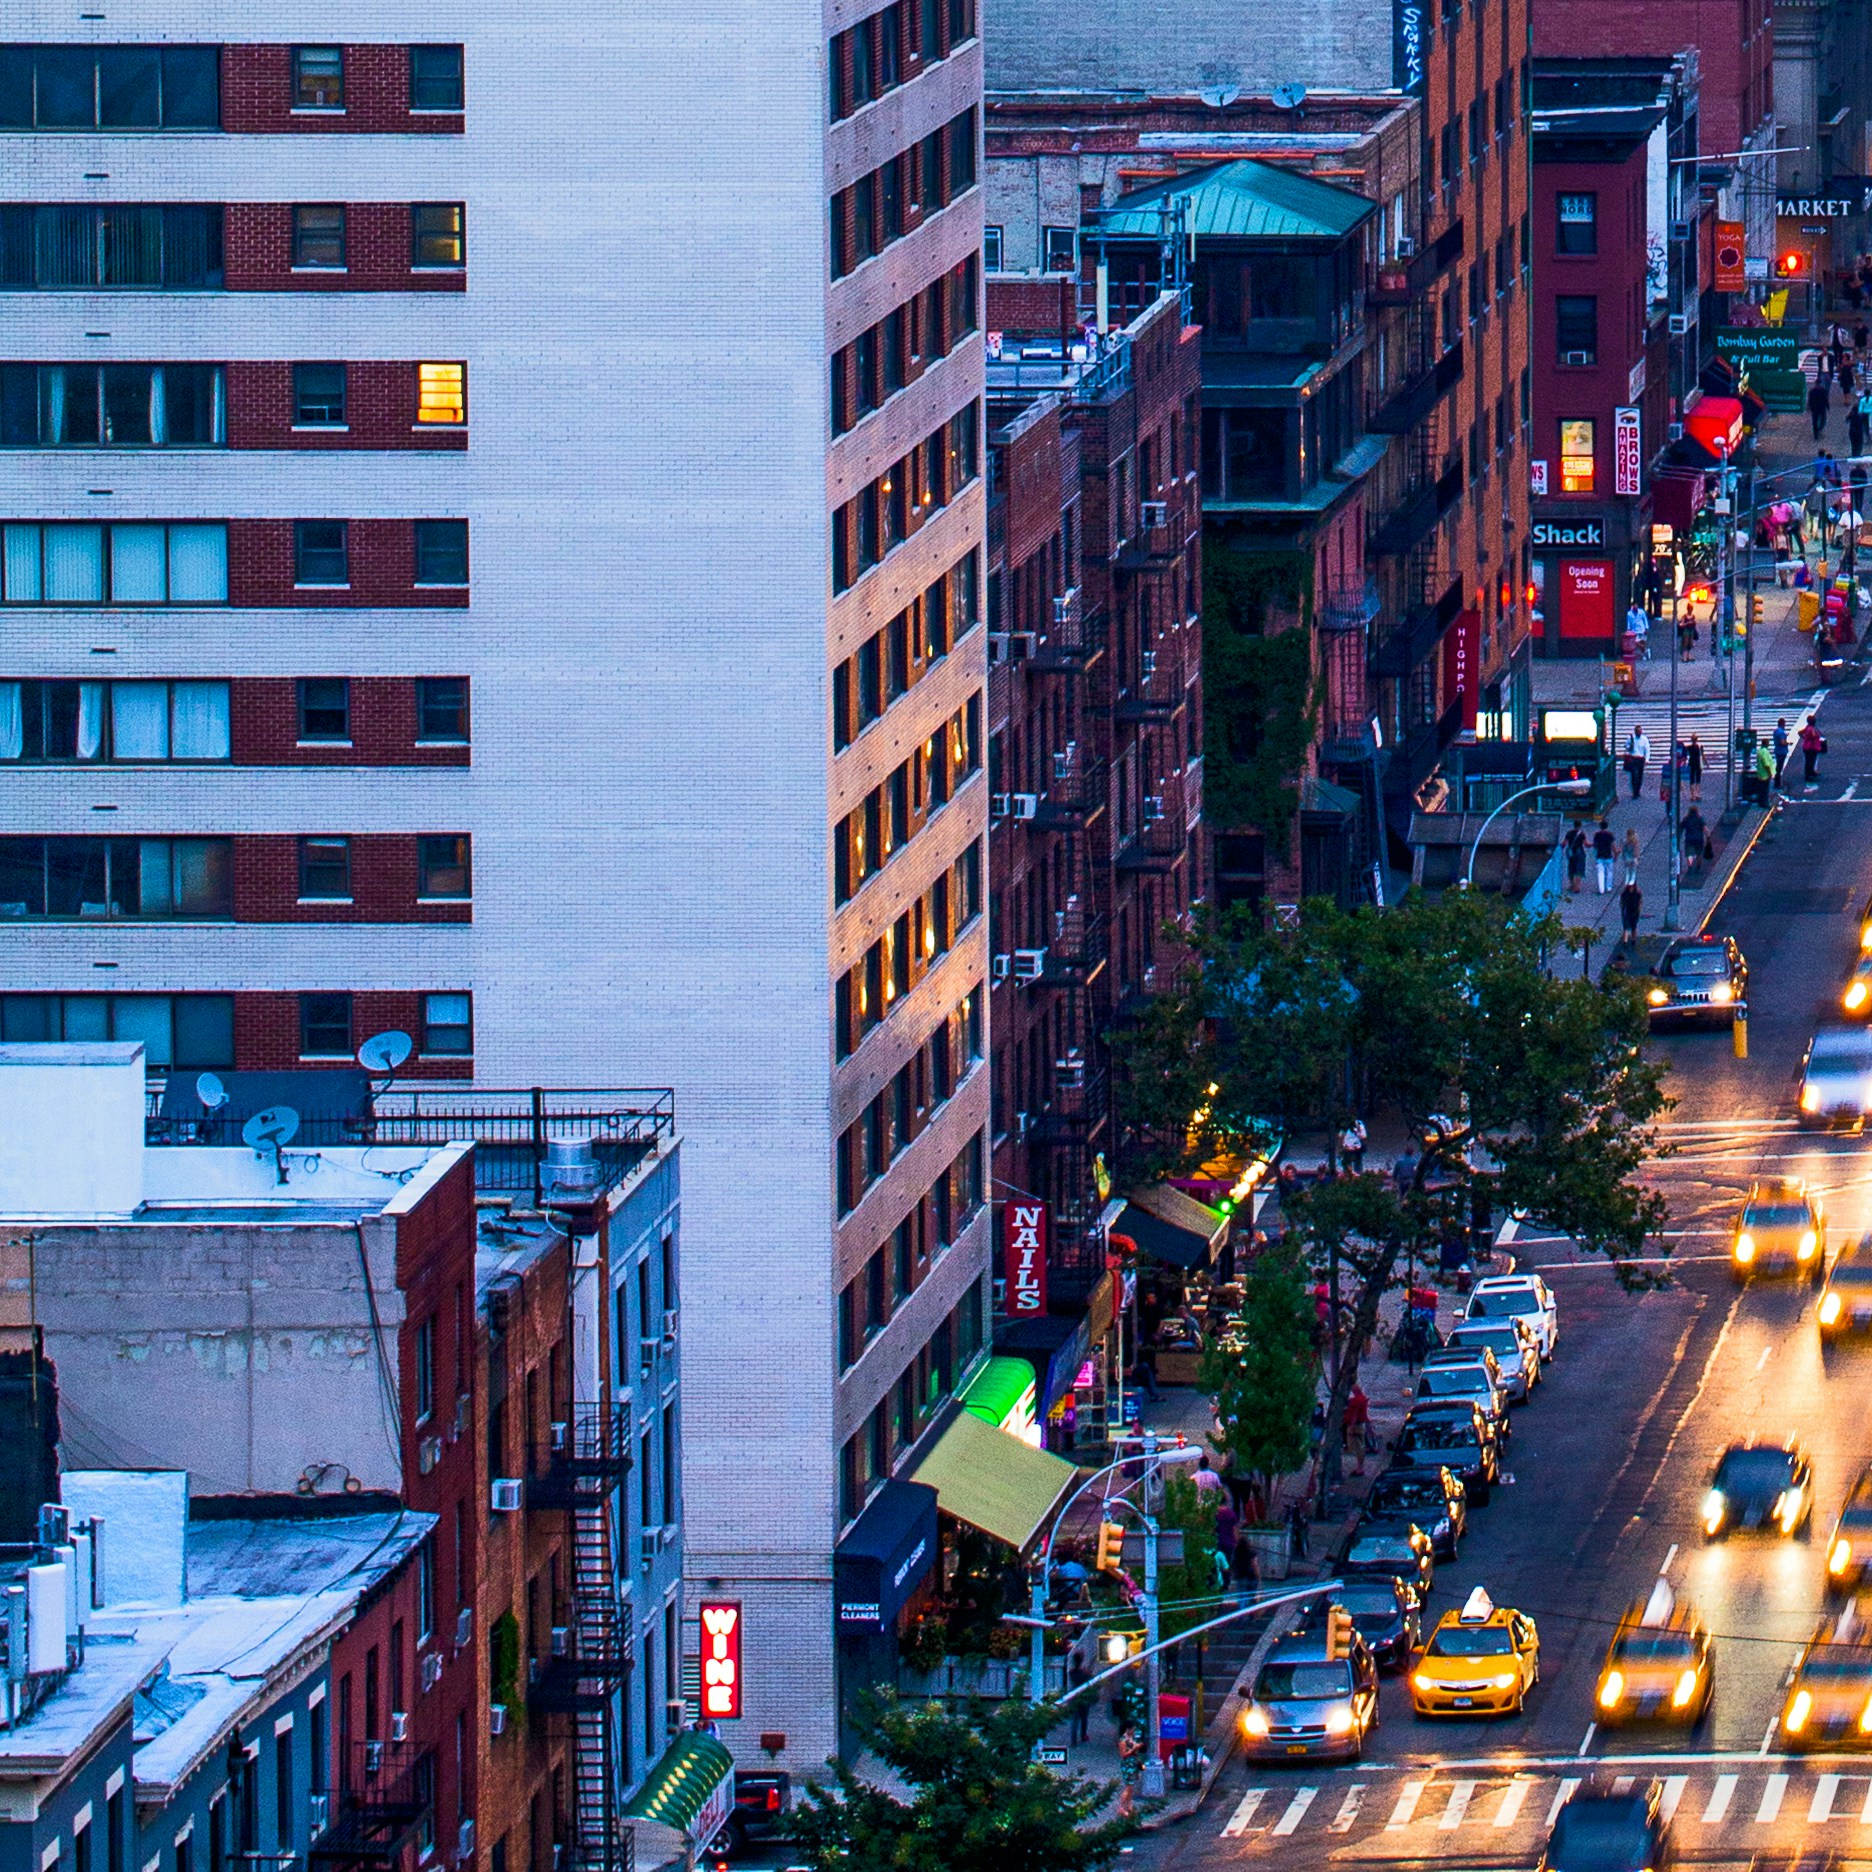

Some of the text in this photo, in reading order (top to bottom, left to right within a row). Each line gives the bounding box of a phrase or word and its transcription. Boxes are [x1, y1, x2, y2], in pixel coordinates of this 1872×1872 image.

[1718, 233, 1741, 242] YOGA
[1717, 335, 1795, 350] Bombay Garden
[1763, 354, 1780, 364] Bar
[1619, 428, 1627, 491] AMAZING
[1628, 427, 1639, 492] BROWS
[1532, 524, 1601, 544] Shack
[1569, 566, 1605, 578] Opening
[1576, 578, 1598, 589] Soon
[1012, 1206, 1043, 1309] NAILS
[841, 1611, 880, 1620] CLEANERS
[703, 1608, 737, 1712] WINE
